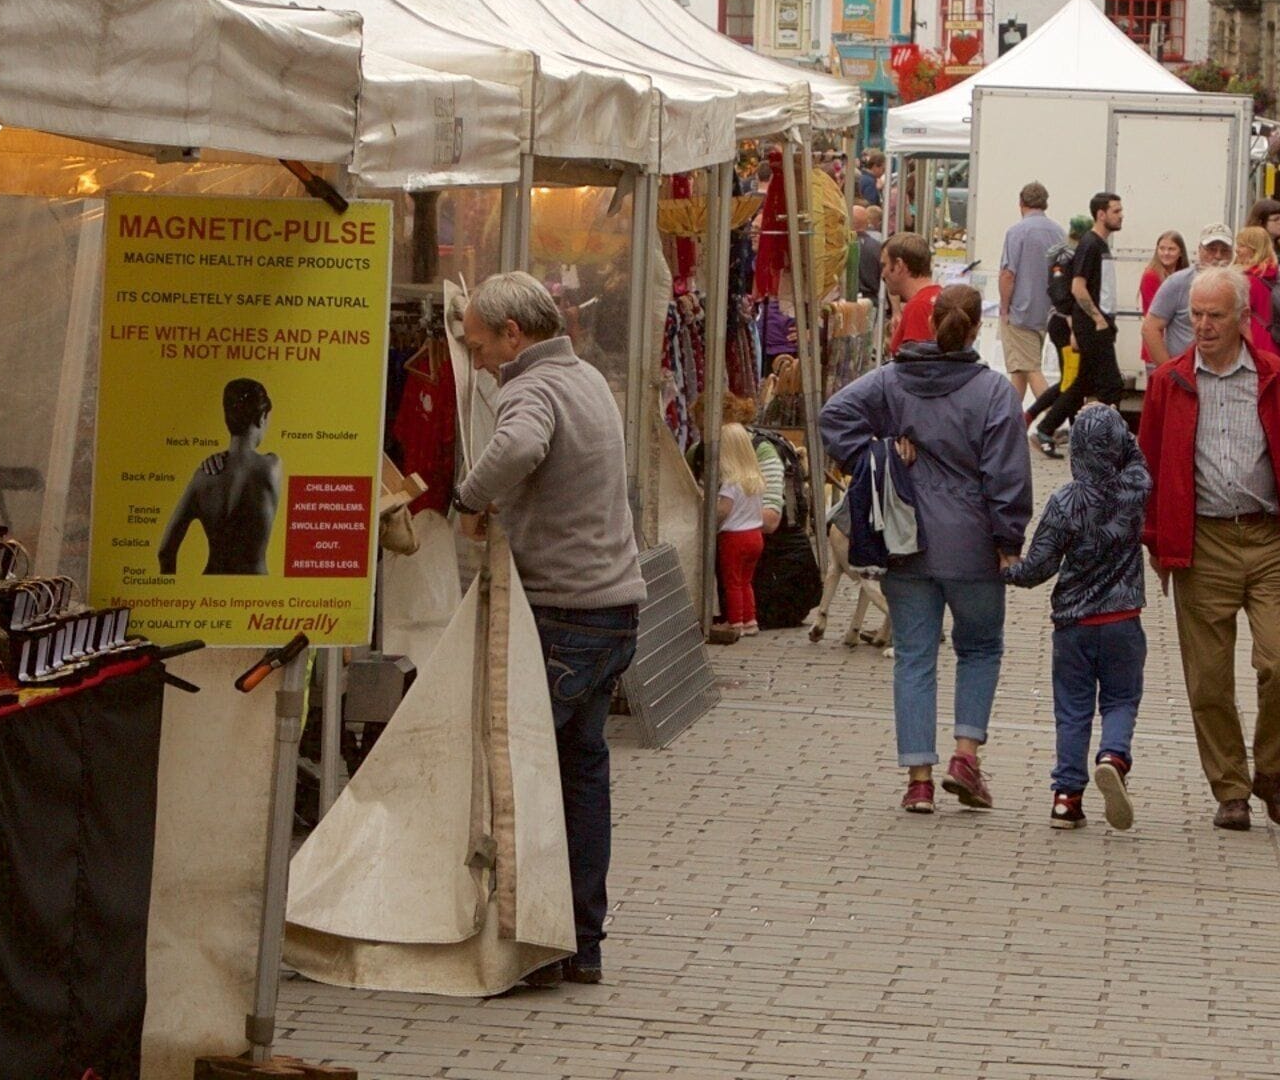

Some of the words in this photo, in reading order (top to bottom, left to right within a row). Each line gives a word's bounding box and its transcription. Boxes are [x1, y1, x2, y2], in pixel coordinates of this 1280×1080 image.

[119, 214, 376, 244] MAGNETIC-PULSE
[124, 252, 196, 265] MAGNETIC
[199, 254, 253, 266] HEALTH
[256, 255, 294, 267] CARE
[298, 256, 370, 270] PRODUCTS
[116, 291, 137, 302] ITS
[141, 291, 233, 304] COMPLETELY
[236, 293, 271, 306] SAFE
[275, 295, 304, 307] AND
[307, 296, 369, 308] NATURAL
[110, 325, 149, 341] LIFE
[154, 326, 201, 341] WITH
[206, 327, 269, 343] ACHES
[274, 329, 312, 344] AND
[318, 330, 370, 345] PAINS
[161, 344, 178, 358] IS
[183, 344, 221, 359] NOT
[226, 345, 279, 360] MUCH
[284, 346, 321, 361] FUN
[281, 430, 313, 440] Frozen
[316, 430, 359, 441] Shoulder
[166, 437, 189, 446] Neck
[192, 438, 220, 447] Pains
[121, 472, 146, 481] Back
[148, 472, 176, 482] Pains
[128, 505, 160, 514] Tennis
[127, 515, 157, 524] Elbow
[111, 537, 150, 547] Sciatica
[123, 566, 146, 575] Poor
[122, 575, 176, 585] Circulation
[111, 596, 196, 610] Magnotherapy
[200, 597, 227, 608] Also
[230, 597, 285, 610] Improves
[288, 597, 352, 609] Circulation
[147, 620, 192, 629] QUALITY
[194, 620, 208, 629] OF
[210, 620, 232, 630] LIFE
[247, 613, 339, 635] Naturally
